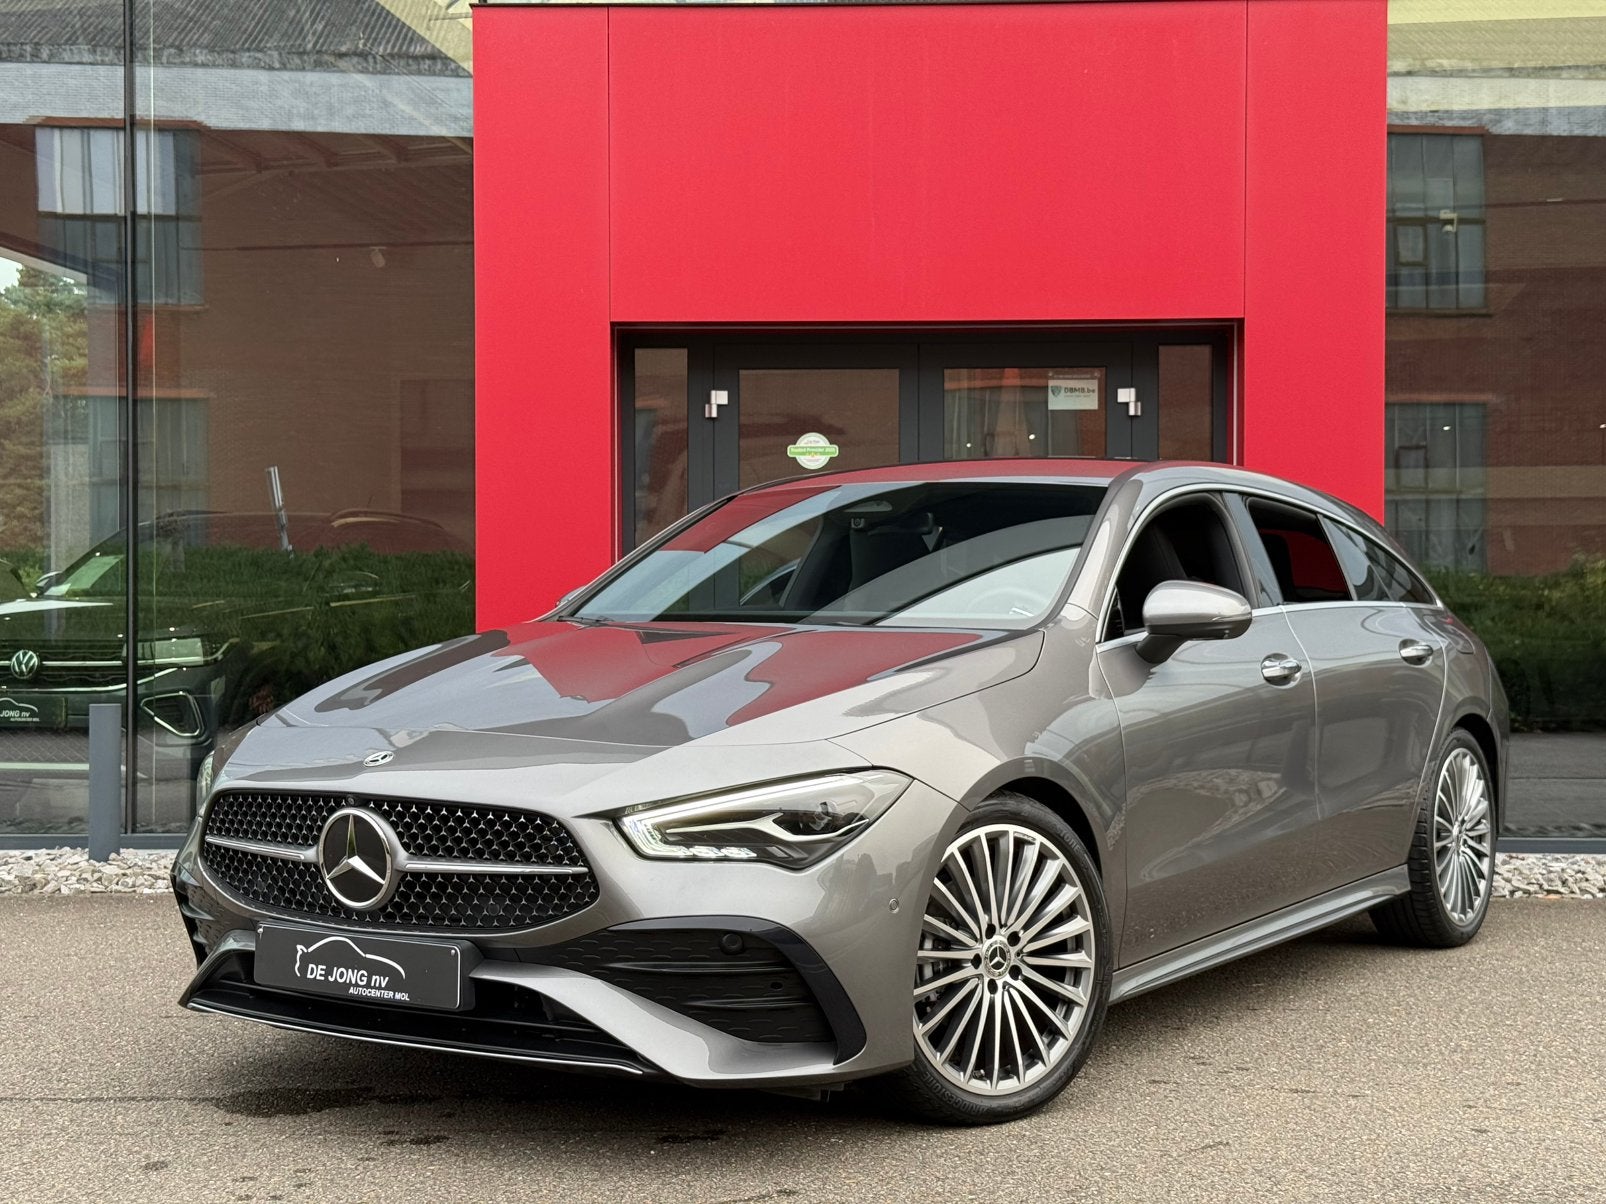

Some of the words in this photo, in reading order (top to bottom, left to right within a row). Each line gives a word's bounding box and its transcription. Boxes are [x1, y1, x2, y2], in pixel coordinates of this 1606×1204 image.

[306, 963, 326, 980] DE
[328, 966, 368, 985] JONG
[371, 975, 389, 987] nv
[348, 986, 394, 999] AUTOCENTER
[394, 992, 410, 1001] MOL
[921, 1071, 989, 1115] BRIDGESTONE
